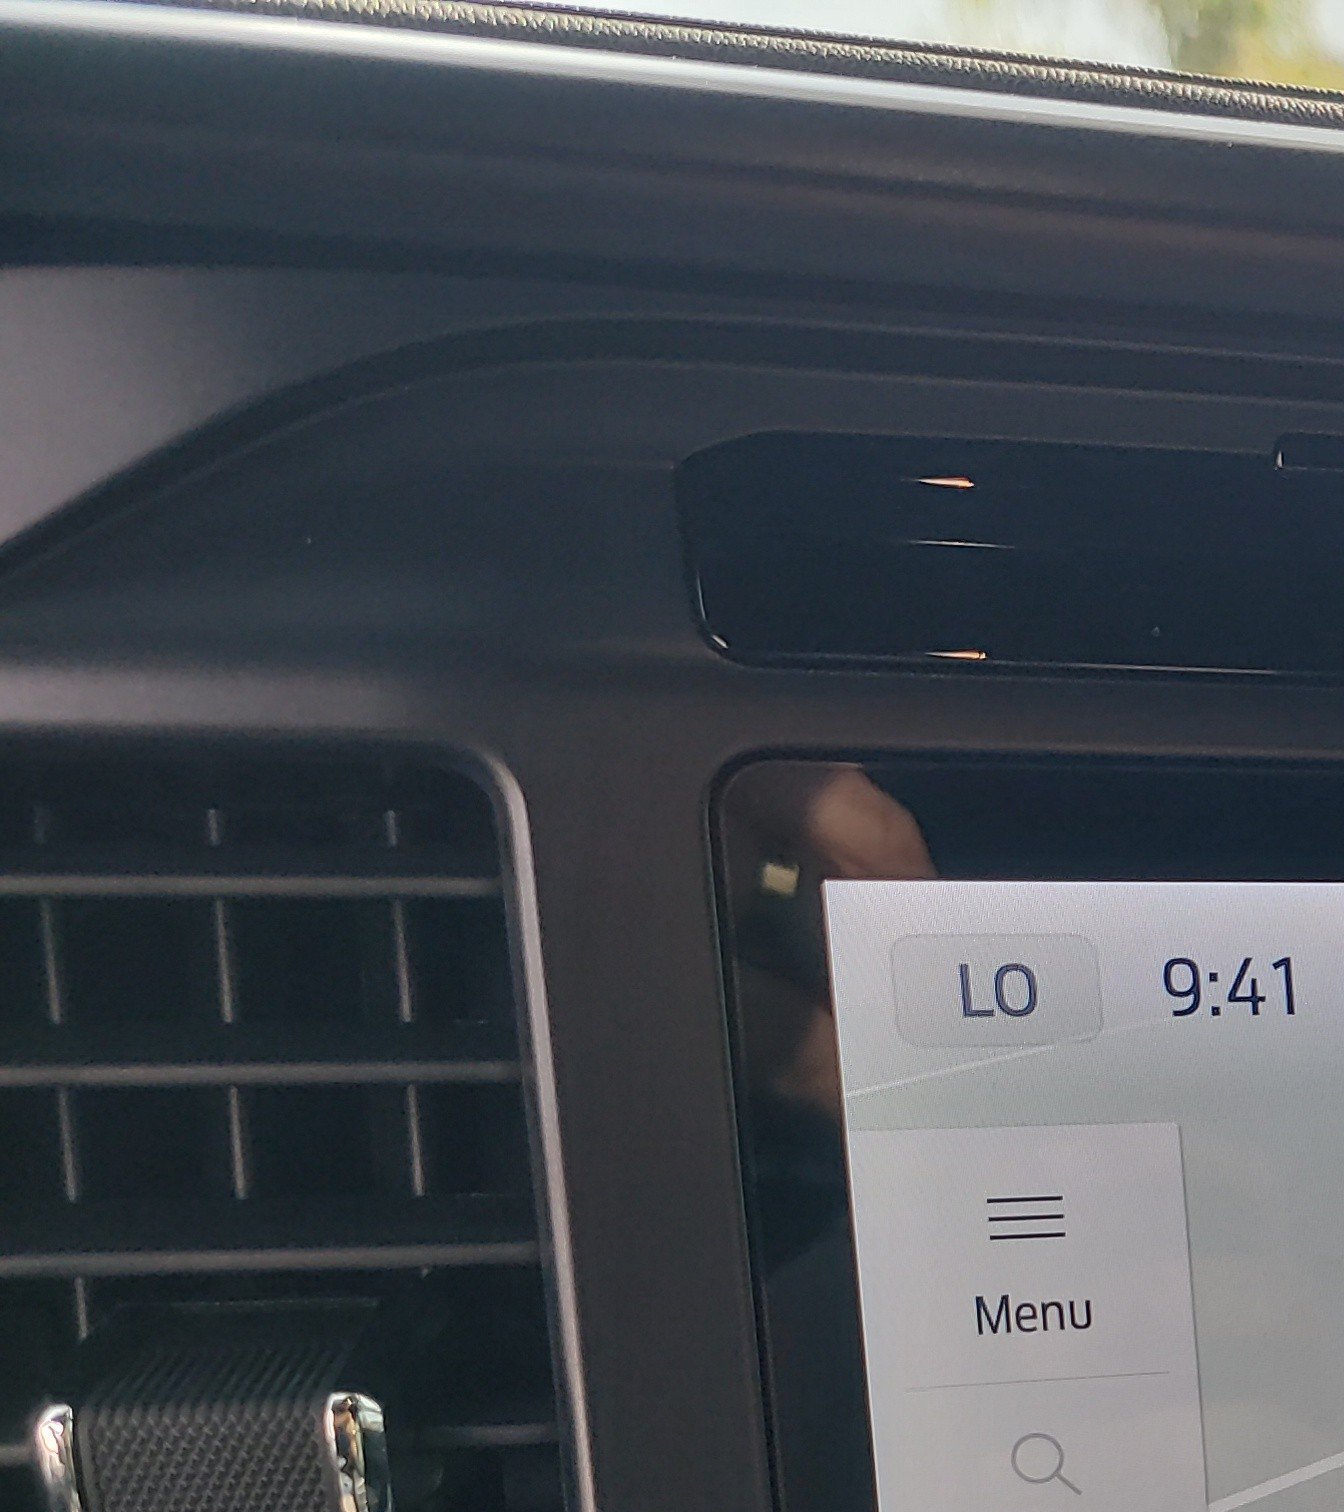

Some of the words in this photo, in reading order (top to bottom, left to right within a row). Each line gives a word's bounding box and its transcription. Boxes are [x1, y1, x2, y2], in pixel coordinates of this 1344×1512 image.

[957, 962, 1039, 1018] LO
[1162, 955, 1297, 1018] 9:41
[974, 1294, 1094, 1336] Menu
